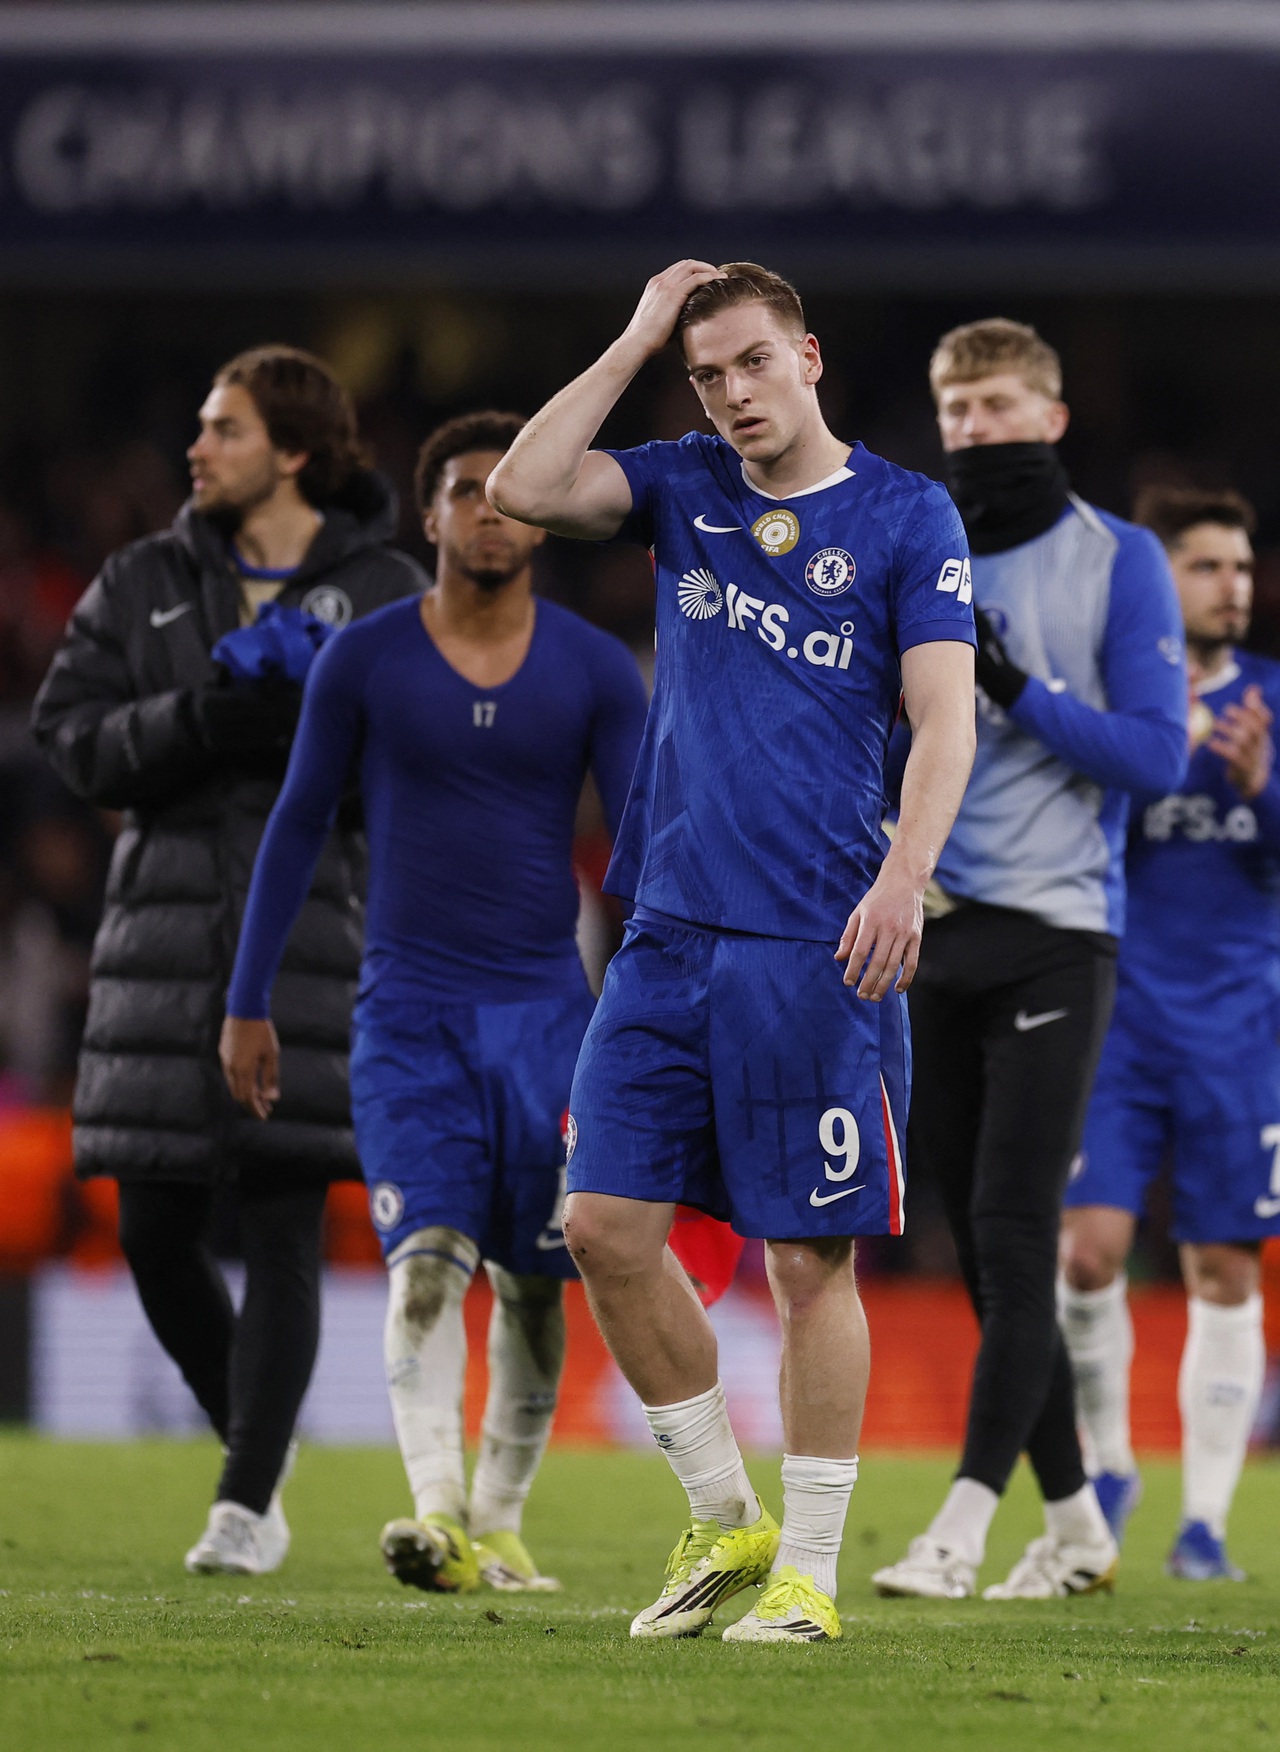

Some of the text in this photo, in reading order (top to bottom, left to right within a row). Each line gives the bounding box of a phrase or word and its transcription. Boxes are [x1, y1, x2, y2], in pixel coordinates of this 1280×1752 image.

[14, 82, 1096, 211] CHAMPIONS LEAGUE
[753, 513, 796, 541] WORLD CHAMPIONS
[816, 549, 849, 561] CHELSEA
[725, 582, 855, 670] IFS.ai
[473, 701, 498, 728] 17
[818, 1107, 860, 1182] 9
